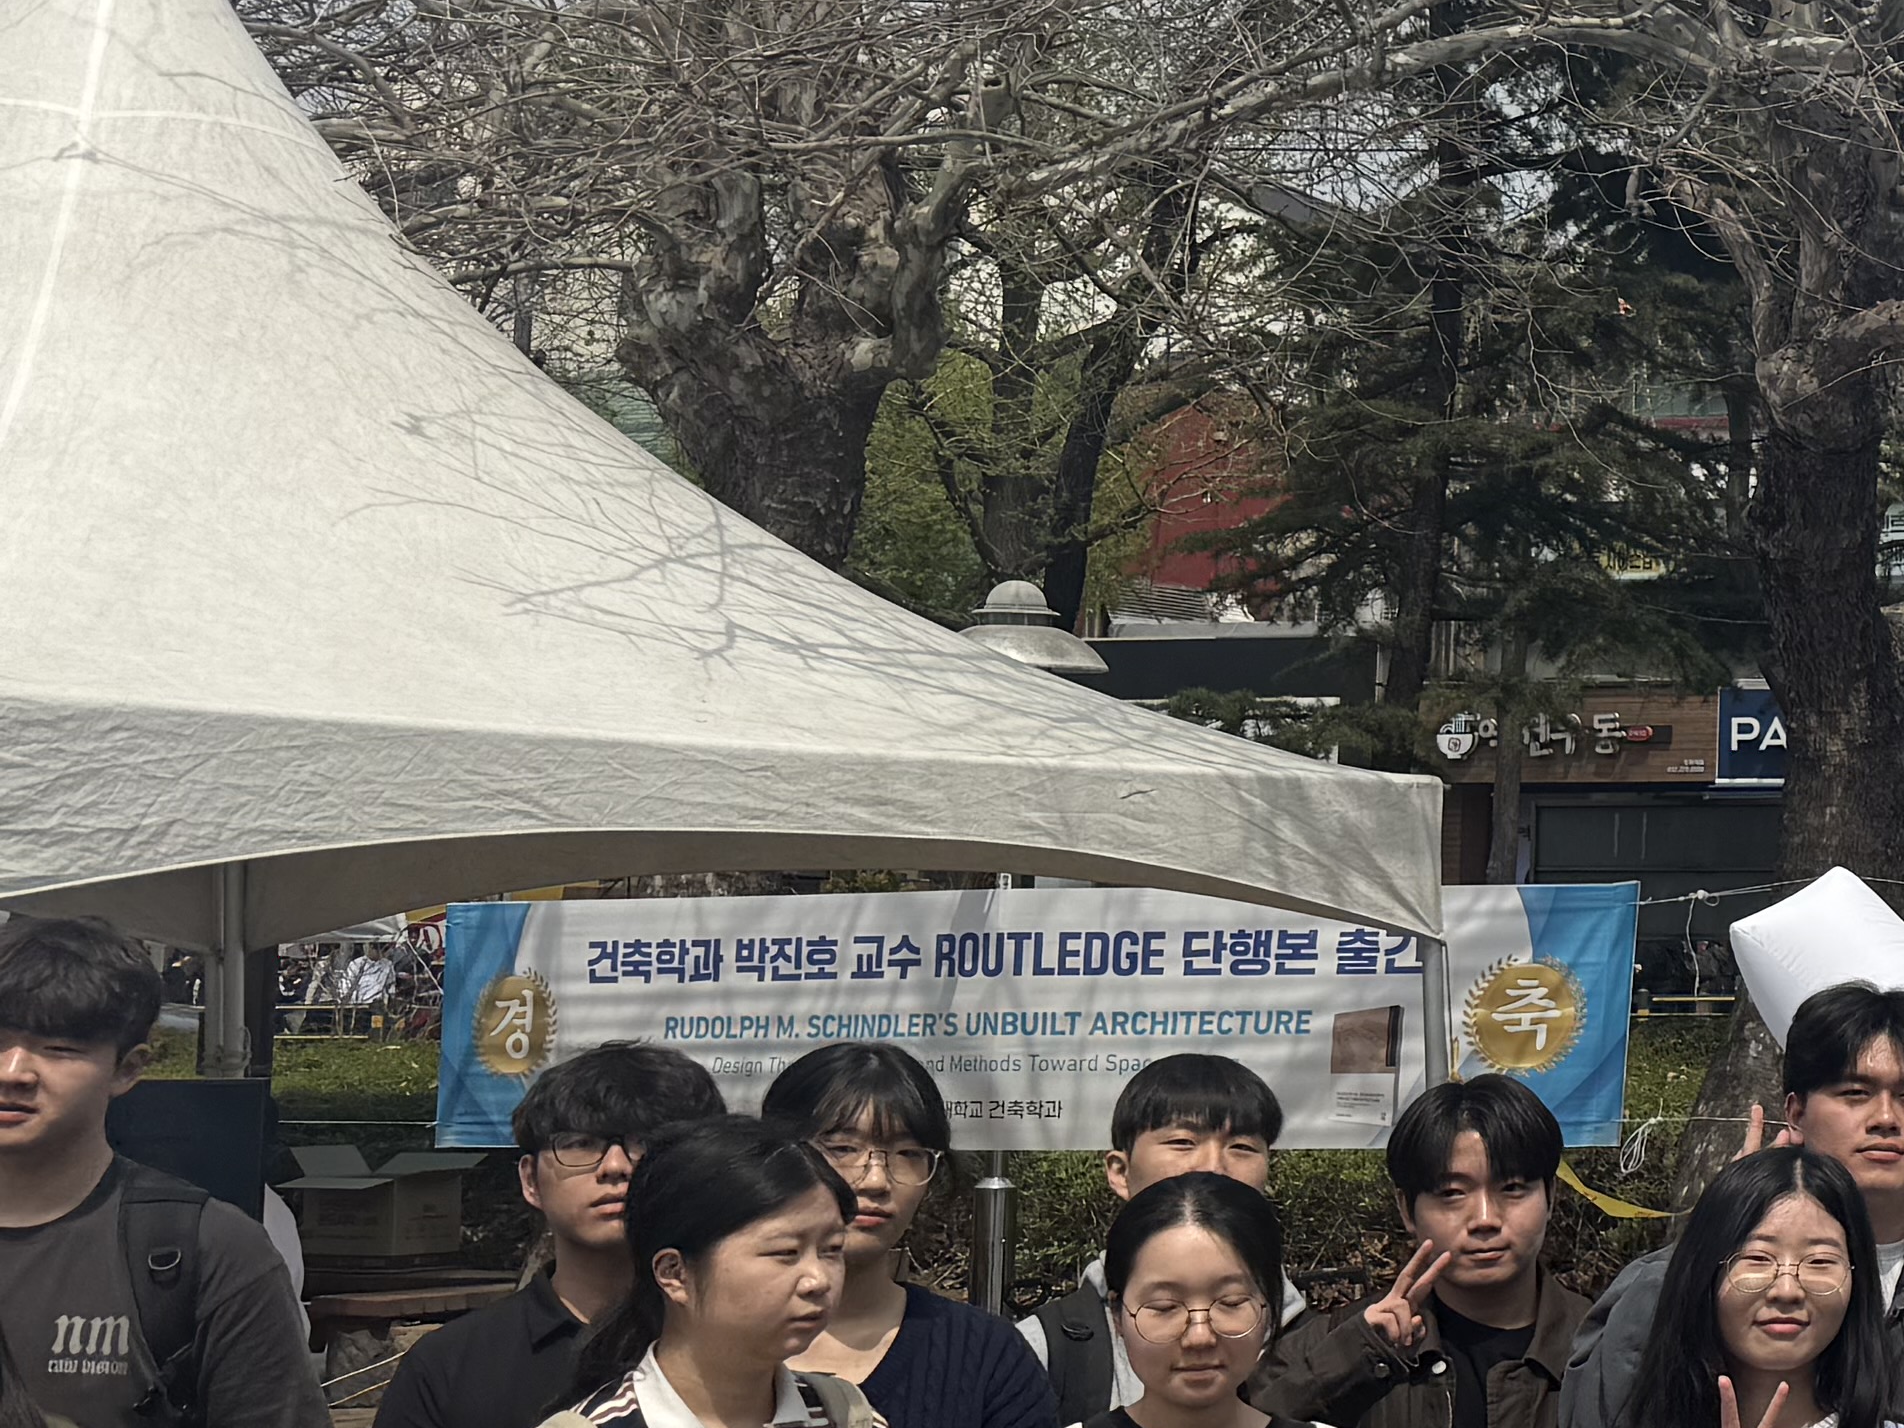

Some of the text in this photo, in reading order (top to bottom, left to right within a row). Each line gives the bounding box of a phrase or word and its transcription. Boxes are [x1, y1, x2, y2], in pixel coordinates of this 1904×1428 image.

[1730, 715, 1788, 751] PA
[586, 938, 723, 984] 건축학과
[734, 936, 838, 984] 박진호
[850, 933, 922, 981] 교수
[935, 930, 1167, 977] ROUTLEDGE
[1181, 928, 1318, 976] 단행본
[489, 988, 535, 1060] 경
[664, 1009, 1314, 1040] RUDOLPH M. SCHINDLER'S UNBUILT ARCHITECTURE
[1490, 979, 1563, 1051] 축
[712, 1056, 765, 1077] Design
[948, 1054, 1023, 1072] Methods
[1029, 1054, 1099, 1072] Toward
[988, 1100, 1063, 1120] 건축학과
